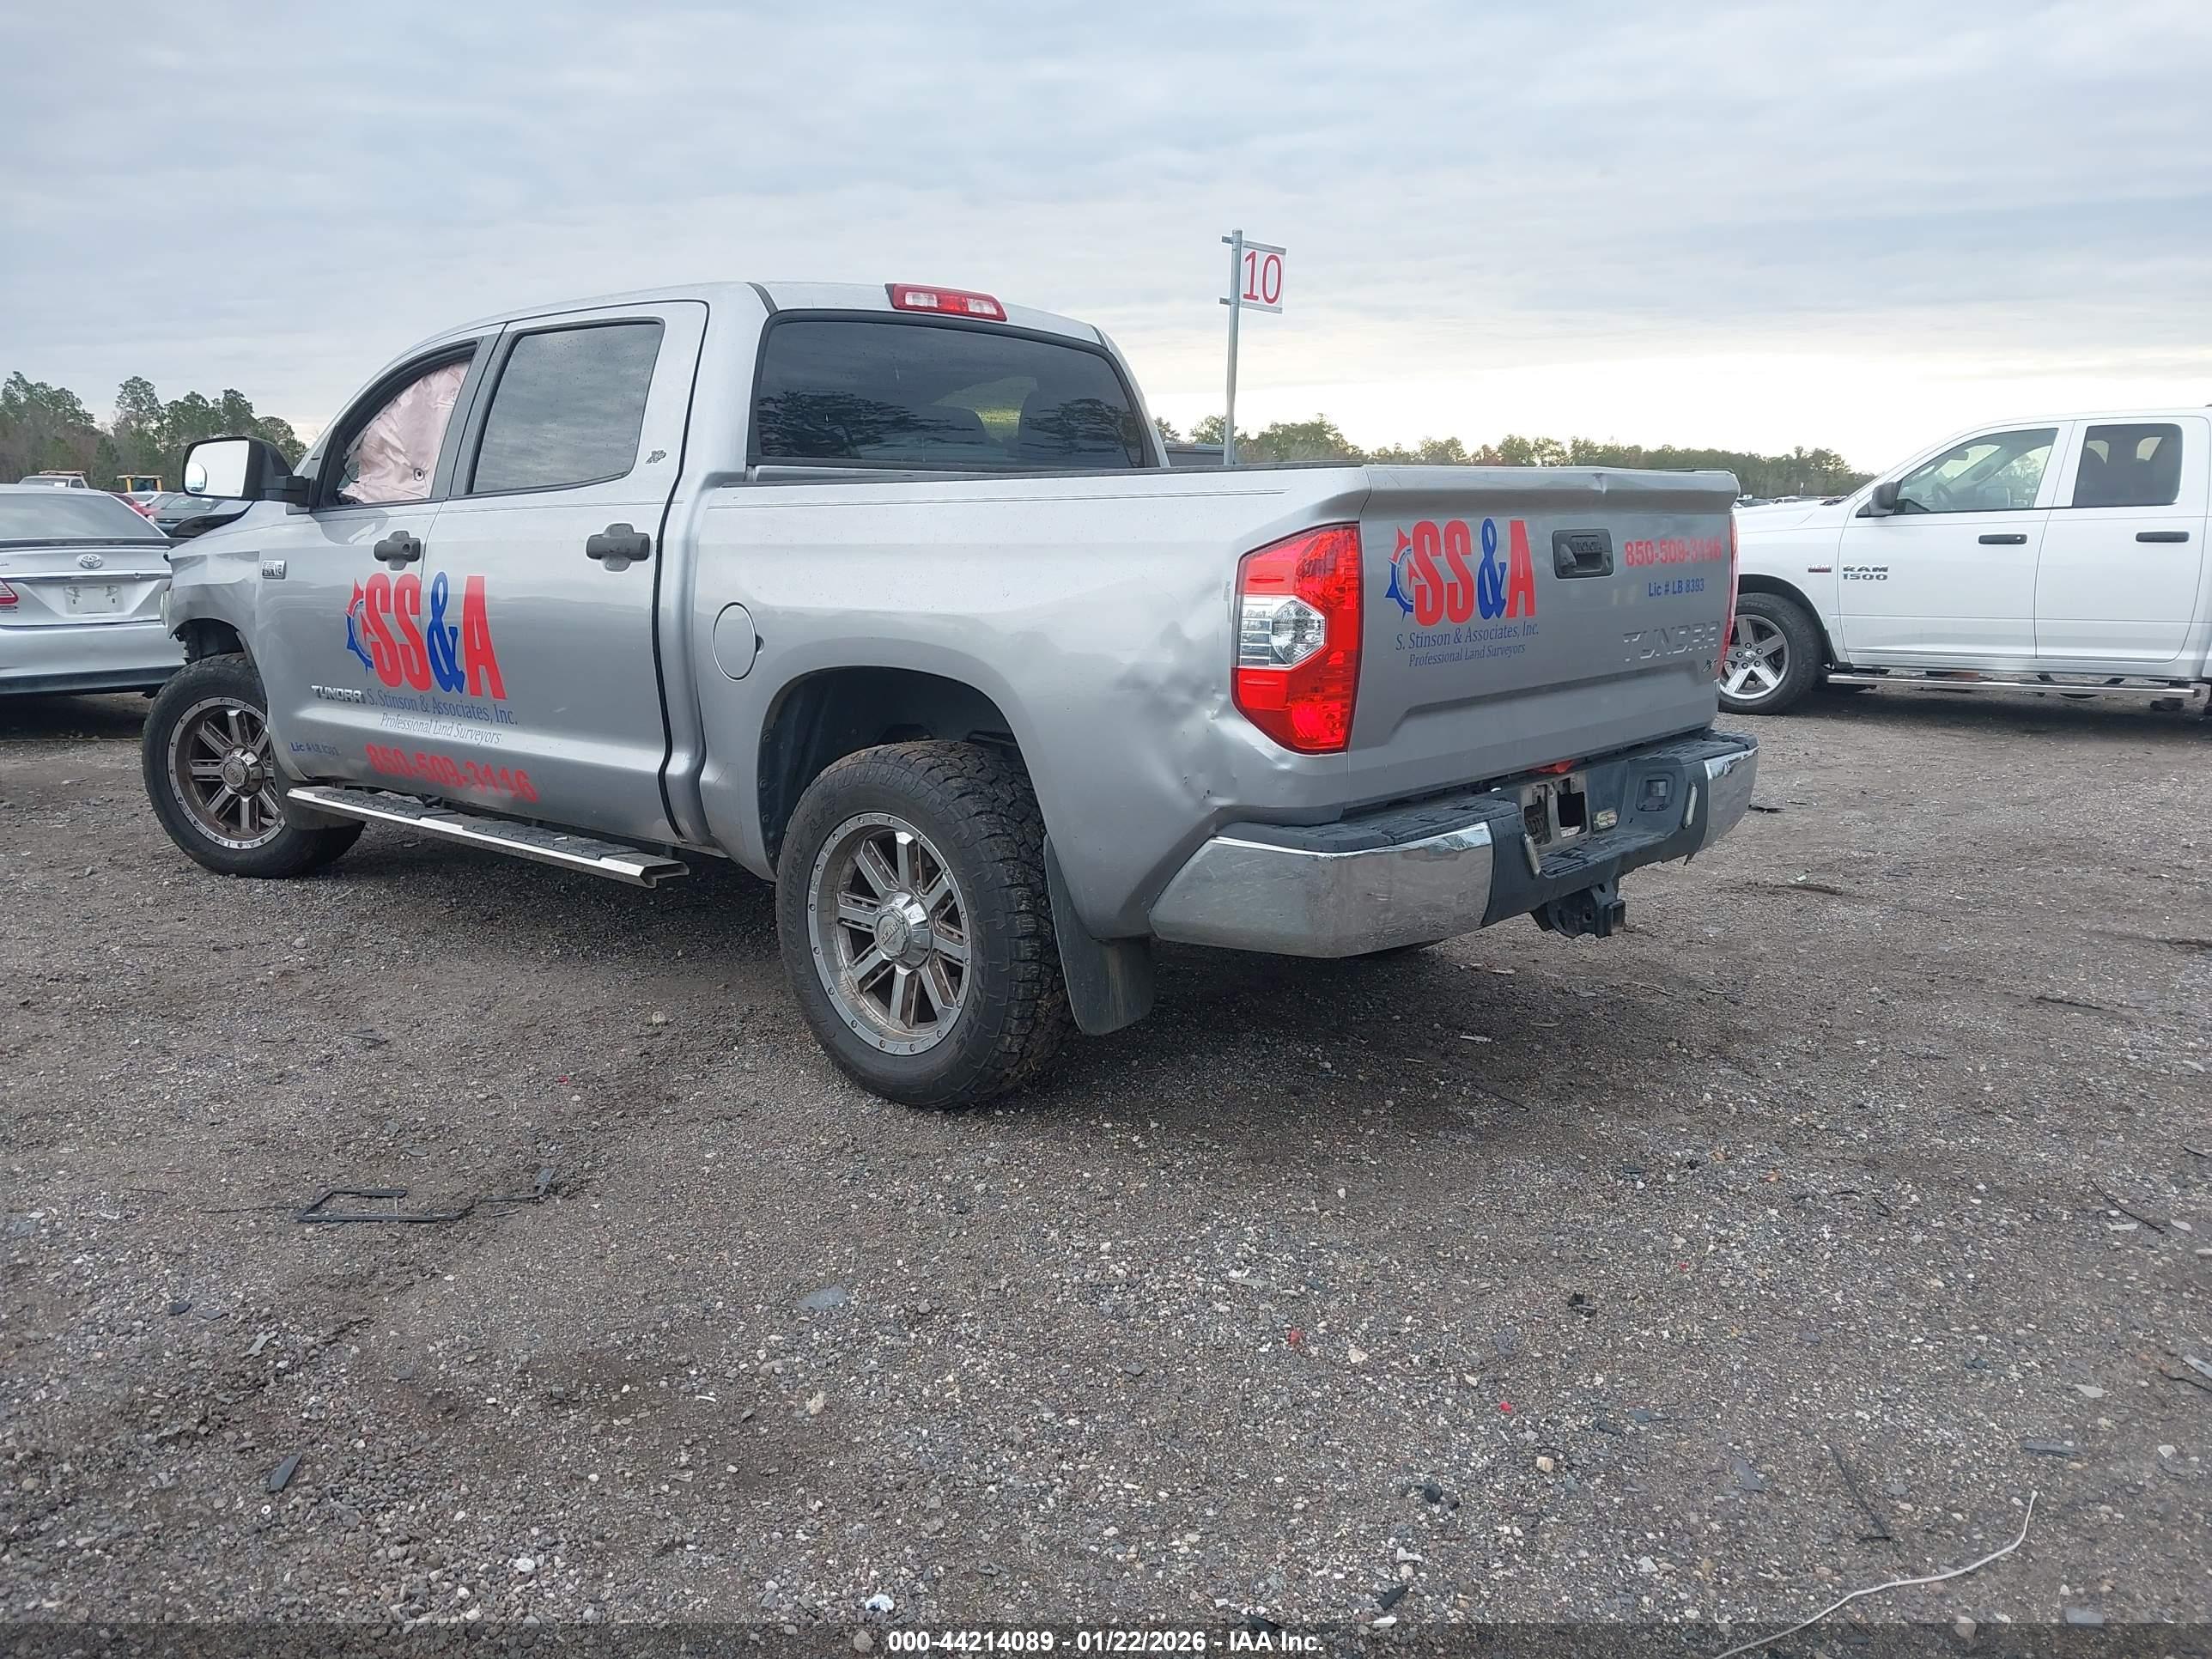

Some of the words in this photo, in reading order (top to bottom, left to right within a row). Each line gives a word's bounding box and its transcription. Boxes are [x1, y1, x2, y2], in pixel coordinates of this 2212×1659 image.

[1243, 251, 1282, 304] 10
[1413, 517, 1536, 627] SS&A
[1648, 582, 1662, 597] Lic
[1664, 584, 1670, 594] #
[1672, 580, 1683, 594] LB
[1686, 578, 1705, 592] 8393
[364, 571, 508, 701] SS&A
[1395, 634, 1406, 651] S.
[1408, 632, 1450, 649] Stinson
[1454, 628, 1462, 644] &
[1464, 623, 1520, 643] Associates,
[1522, 621, 1539, 636] Inc.
[1623, 621, 1721, 662] TUNDRA
[1408, 647, 1462, 667] Professional
[1465, 647, 1485, 660] Land
[1486, 644, 1526, 659] Surveyors
[311, 684, 366, 704] TUNDRA
[367, 689, 378, 706] S.
[378, 690, 418, 712] Stinson
[419, 695, 428, 713] &
[433, 697, 494, 725] Associates,
[495, 703, 518, 726] Inc.
[380, 713, 432, 732] Professional
[433, 720, 454, 735] Land
[453, 723, 501, 745] Surveyors
